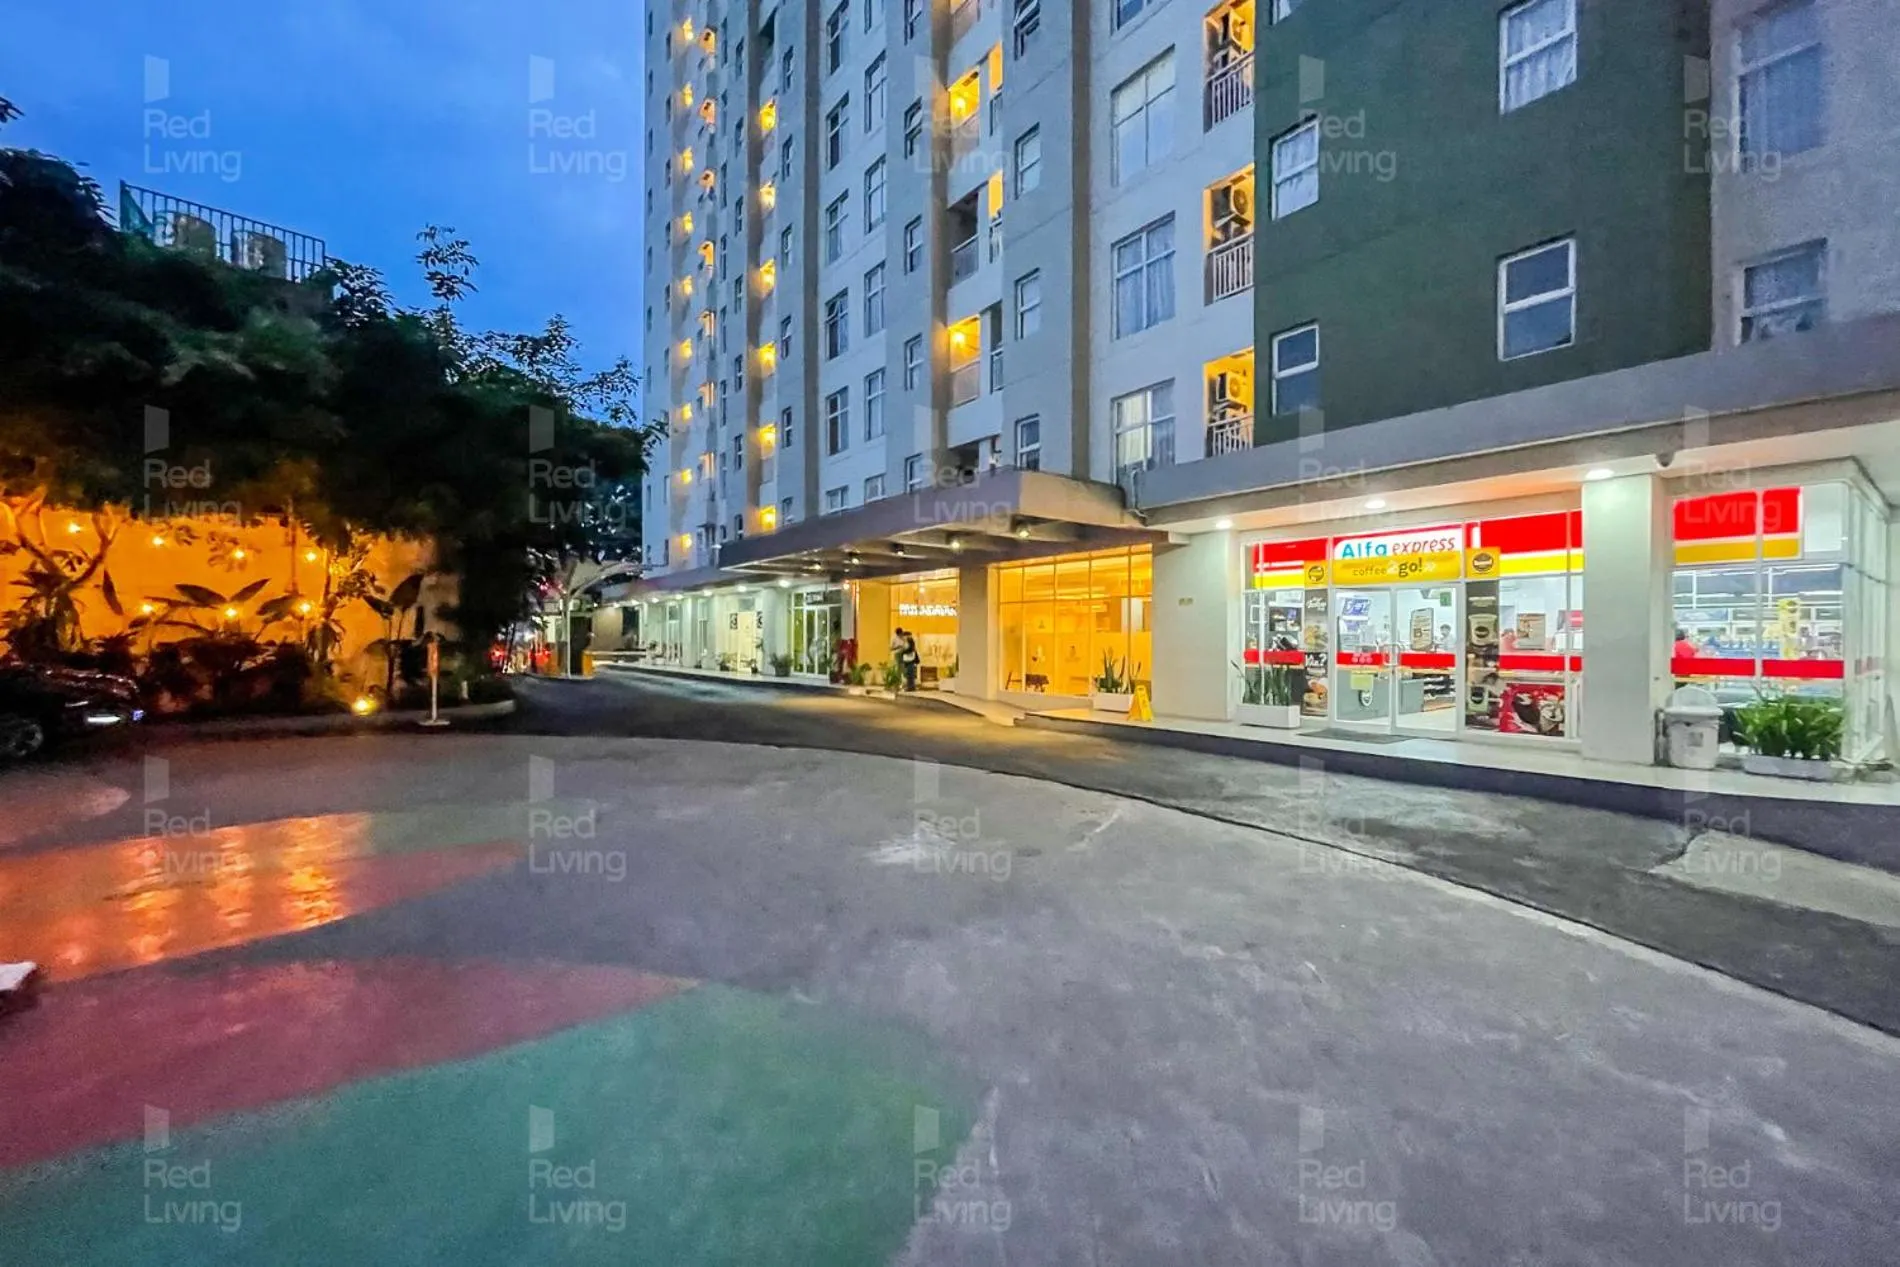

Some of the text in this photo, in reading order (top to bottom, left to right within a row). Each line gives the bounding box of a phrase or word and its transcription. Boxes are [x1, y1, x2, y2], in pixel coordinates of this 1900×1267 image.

[1342, 537, 1456, 558] Alfa express
[1353, 565, 1388, 577] coffee
[1398, 557, 1422, 578] go!
